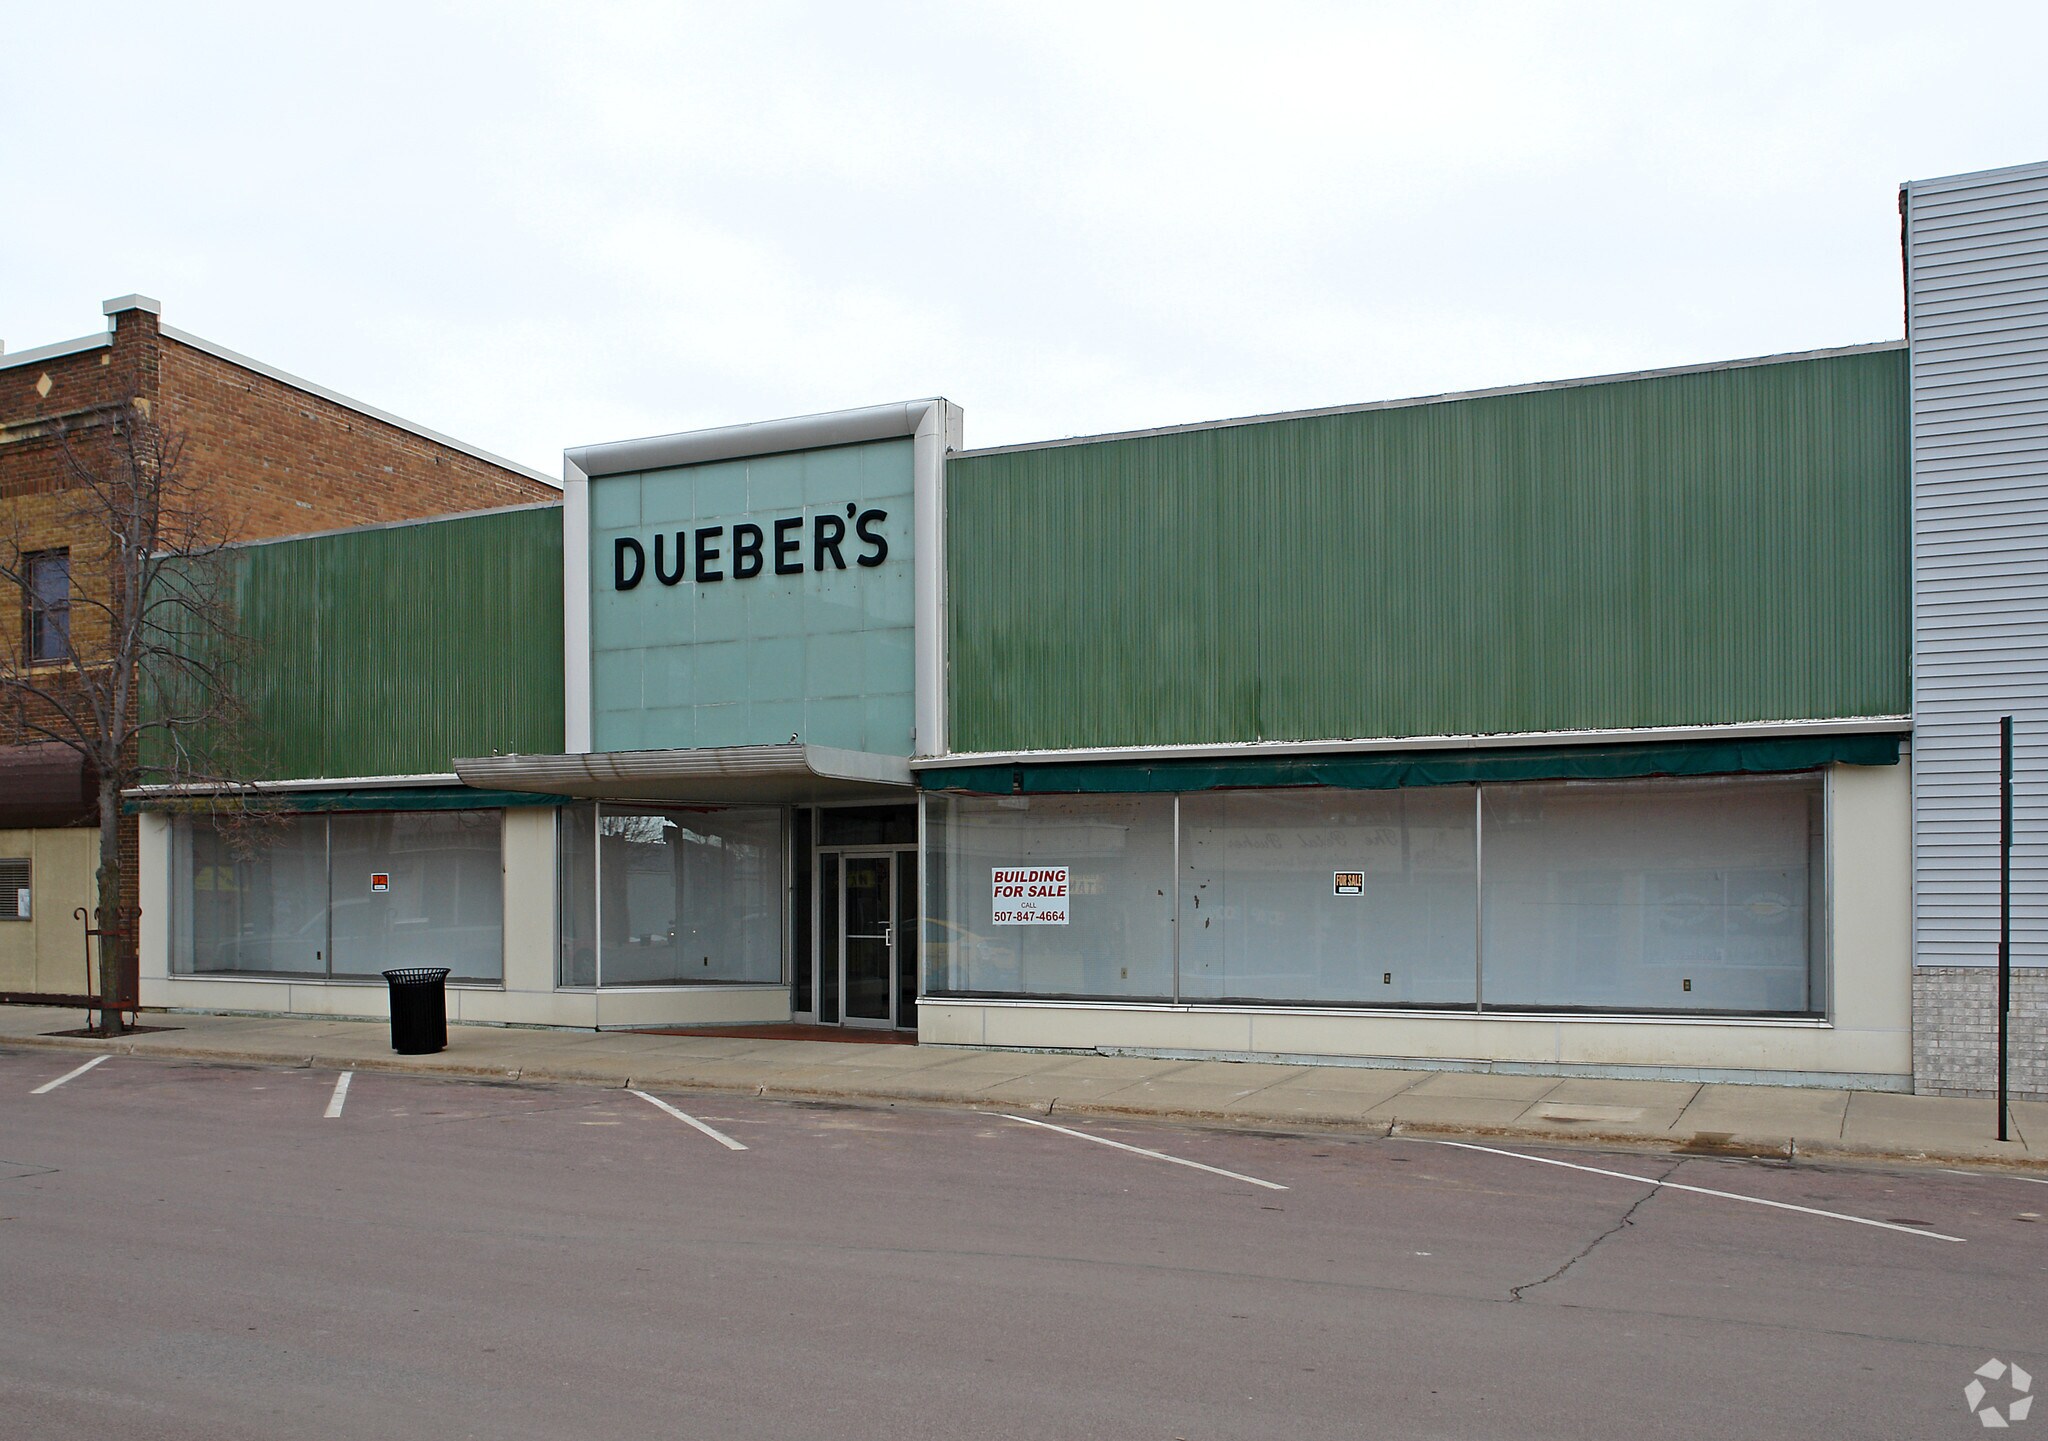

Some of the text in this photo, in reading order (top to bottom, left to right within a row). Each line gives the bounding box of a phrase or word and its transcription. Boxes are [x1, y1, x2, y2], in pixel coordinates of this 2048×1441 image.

[615, 502, 888, 590] DUEBER'S
[994, 870, 1066, 883] BUILDING
[1336, 874, 1362, 886] FOR SALE
[994, 885, 1067, 898] FOR SALE
[994, 910, 1065, 922] 507-847-4664
